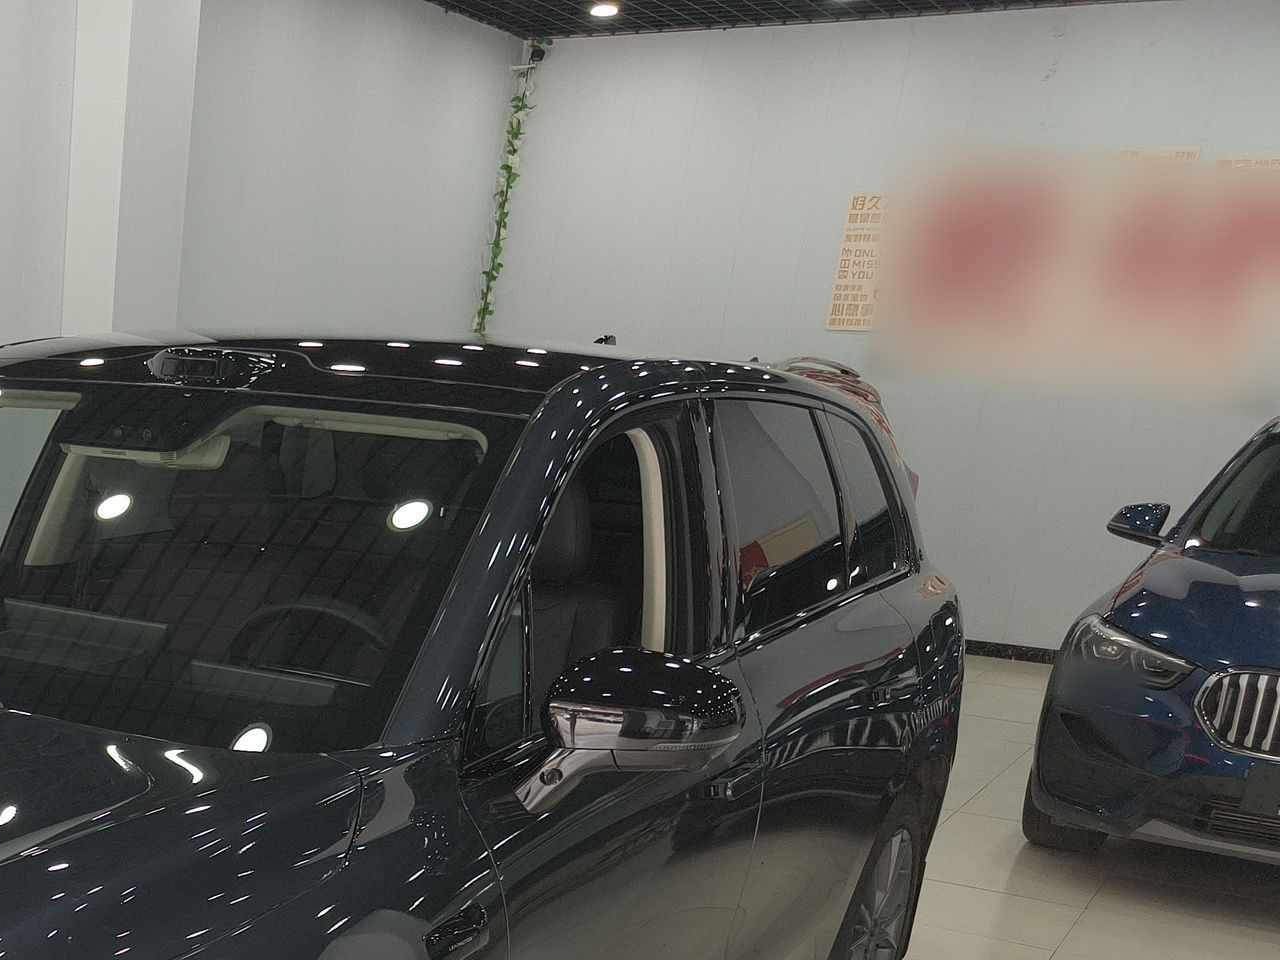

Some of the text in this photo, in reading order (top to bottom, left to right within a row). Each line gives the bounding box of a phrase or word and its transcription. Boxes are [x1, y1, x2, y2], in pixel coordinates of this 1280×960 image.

[851, 271, 874, 280] YOU
[831, 304, 876, 316] 心想事
